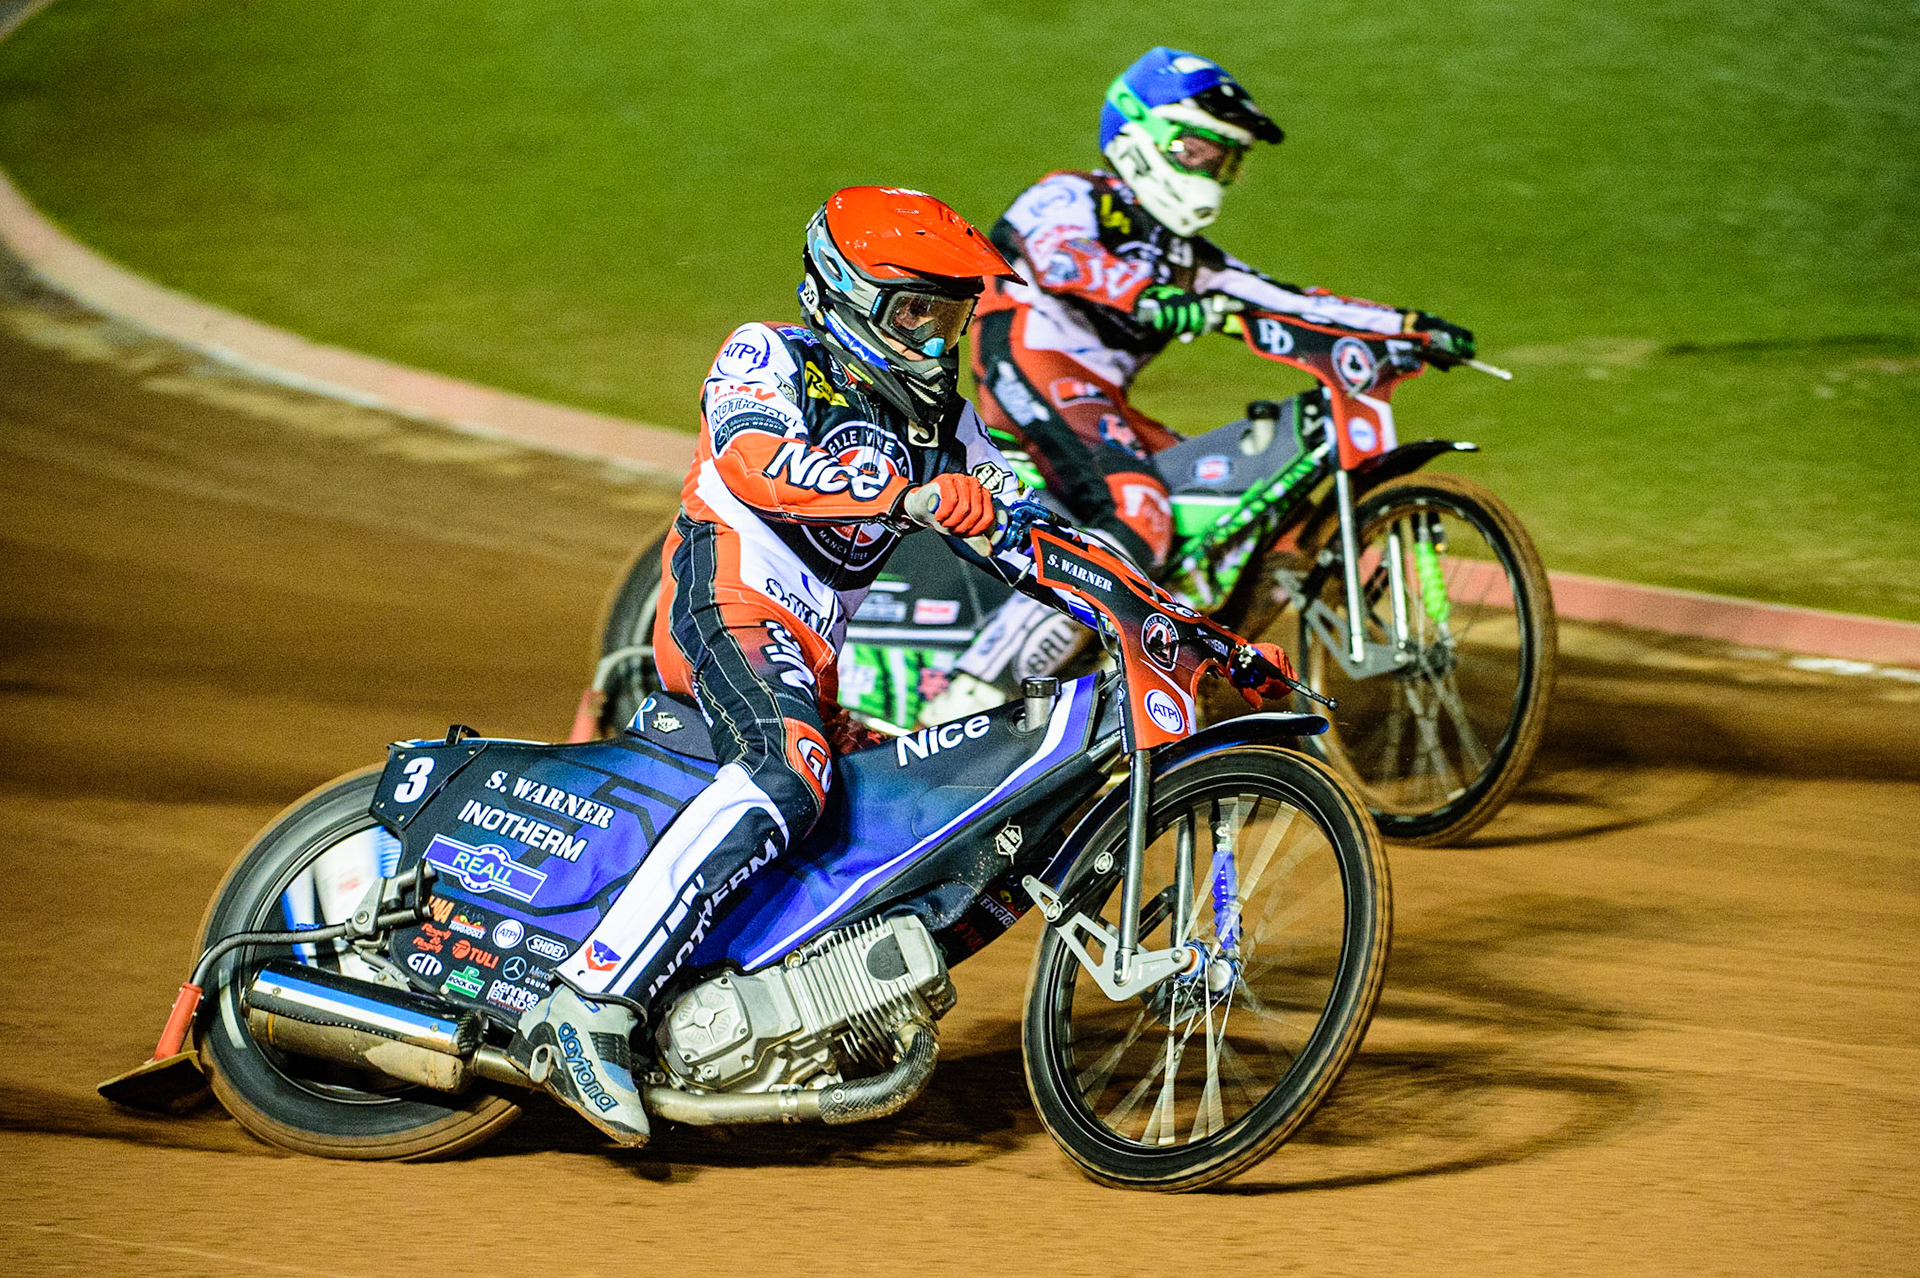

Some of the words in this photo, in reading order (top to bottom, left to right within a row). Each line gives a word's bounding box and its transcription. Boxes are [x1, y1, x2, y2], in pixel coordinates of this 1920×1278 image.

[827, 430, 858, 457] ELLE
[1046, 553, 1060, 568] S.
[1061, 558, 1113, 592] WARNER
[1153, 702, 1179, 723] ATPI
[896, 714, 991, 768] Nice
[393, 756, 436, 804] 3
[484, 769, 509, 793] S.
[512, 776, 616, 829] WARNER
[456, 799, 589, 863] INOTHERM
[452, 851, 511, 887] REALL
[498, 927, 518, 940] ATPI
[469, 949, 500, 969] TULI
[531, 937, 564, 958] SHOEI
[407, 952, 443, 976] GM
[486, 979, 540, 1004] pennine
[524, 977, 551, 992] GRUPA
[558, 1021, 620, 1114] daytona
